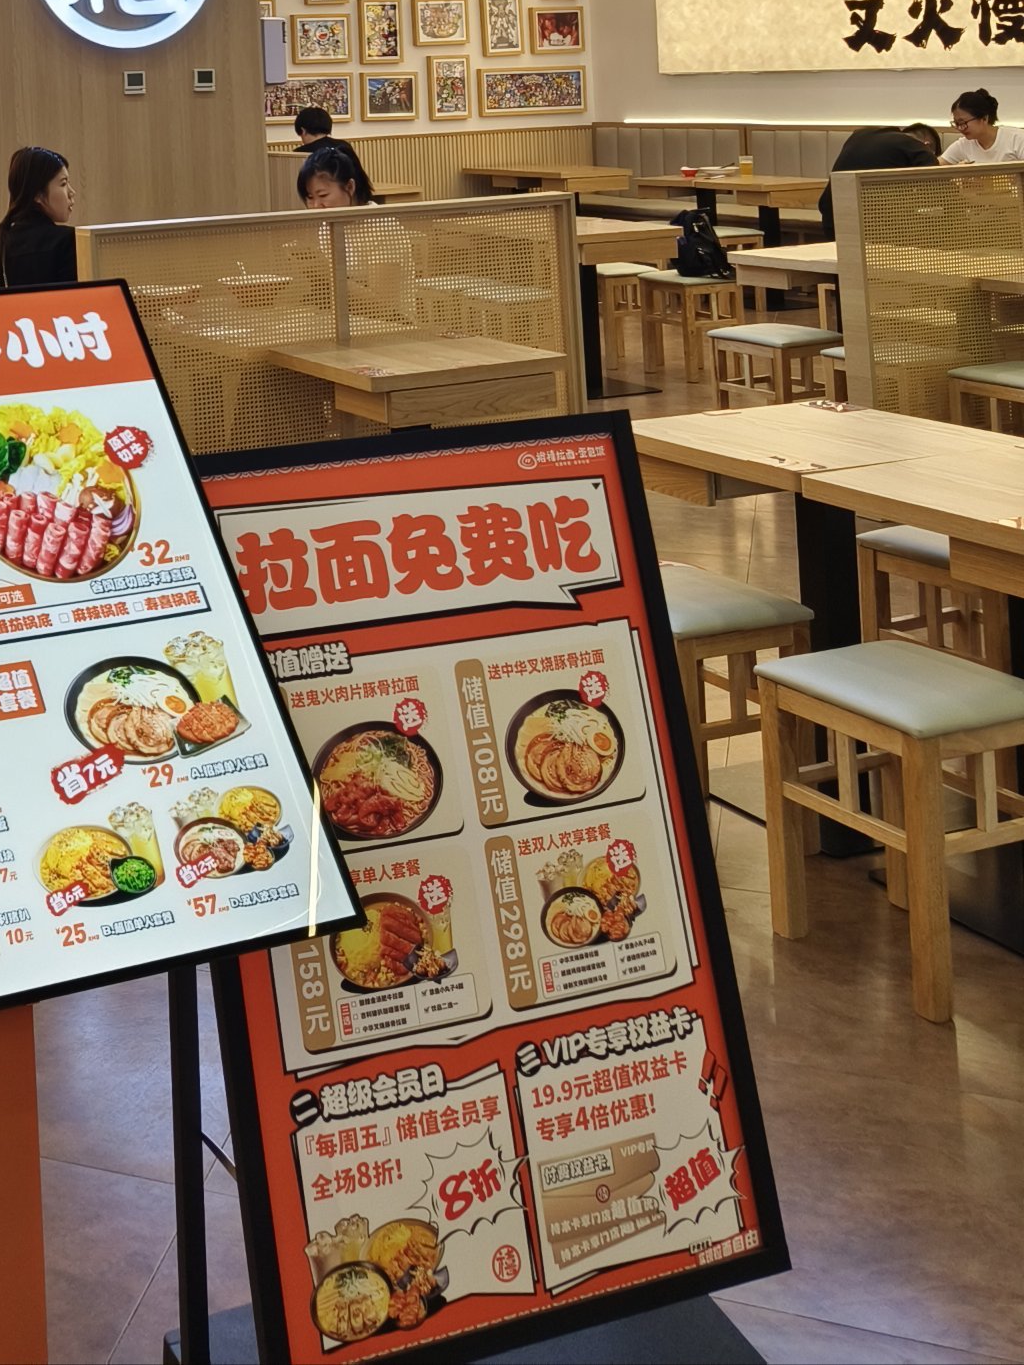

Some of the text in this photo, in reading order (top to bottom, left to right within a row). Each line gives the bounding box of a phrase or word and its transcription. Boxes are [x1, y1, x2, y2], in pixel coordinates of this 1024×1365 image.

[235, 493, 602, 614] 拉面免费吃
[71, 601, 130, 623] 麻辣锅底
[144, 590, 201, 611] 寿喜锅底
[488, 649, 605, 680] 送中华叉烧豚骨拉面
[291, 675, 419, 709] 送鬼火肉片豚骨拉面
[518, 823, 611, 857] 送双人欢享套餐
[6, 928, 34, 945] 10元
[320, 1064, 446, 1118] 超级会员日
[531, 1050, 688, 1108] 19.9元超值权益卡
[439, 1159, 502, 1221] 8折
